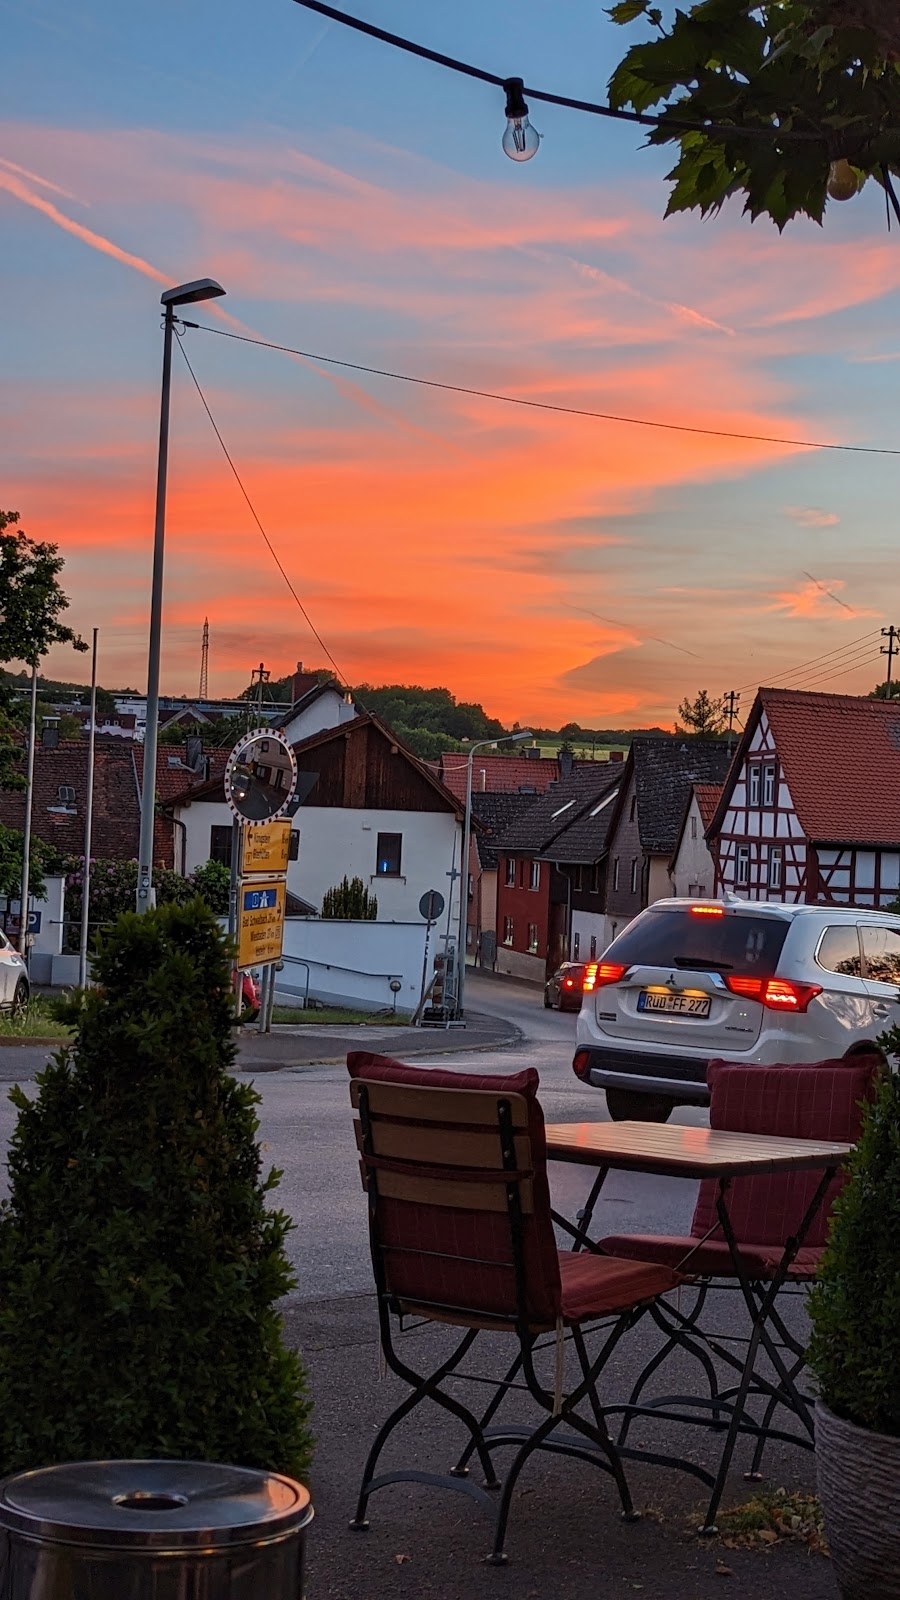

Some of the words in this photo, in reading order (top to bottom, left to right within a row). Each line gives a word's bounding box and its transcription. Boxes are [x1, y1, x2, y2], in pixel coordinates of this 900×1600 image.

[645, 995, 667, 1009] RÜD
[672, 997, 687, 1010] FF
[687, 999, 709, 1013] 277
